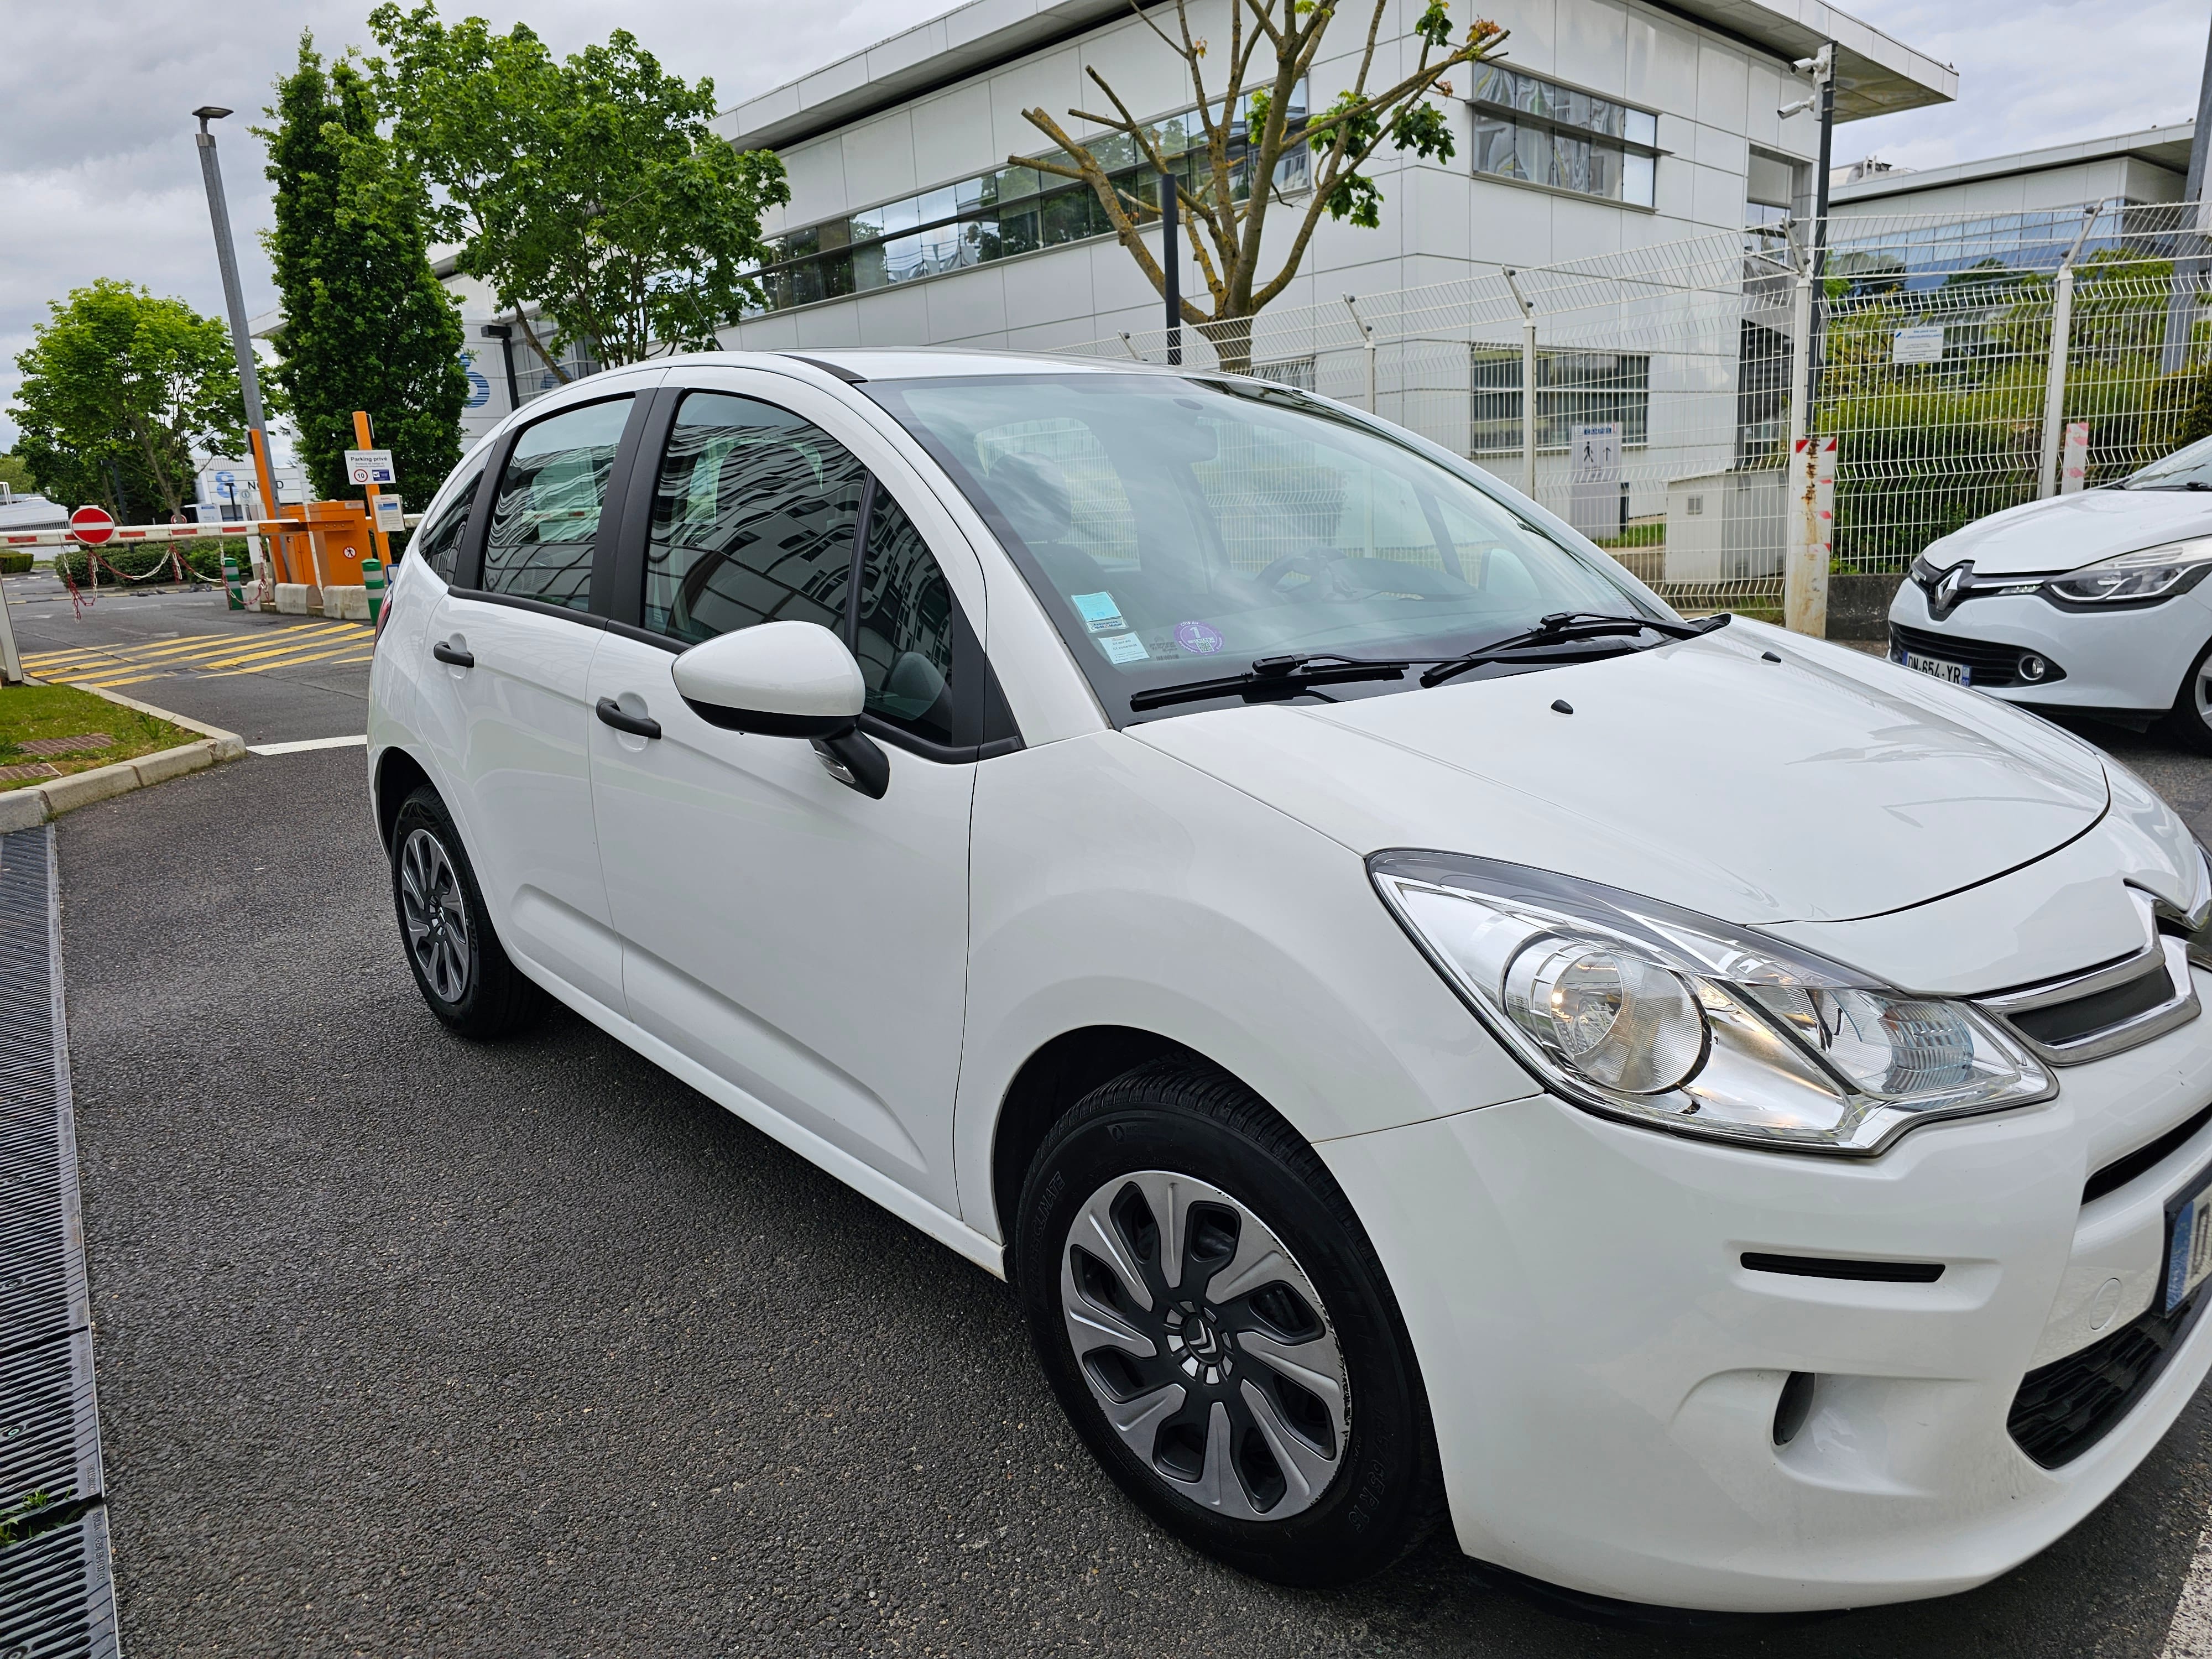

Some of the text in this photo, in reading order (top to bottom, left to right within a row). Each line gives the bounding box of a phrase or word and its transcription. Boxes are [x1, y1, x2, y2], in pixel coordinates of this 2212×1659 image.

[215, 471, 239, 498] 8
[248, 480, 284, 490] ND
[1190, 626, 1201, 639] 1
